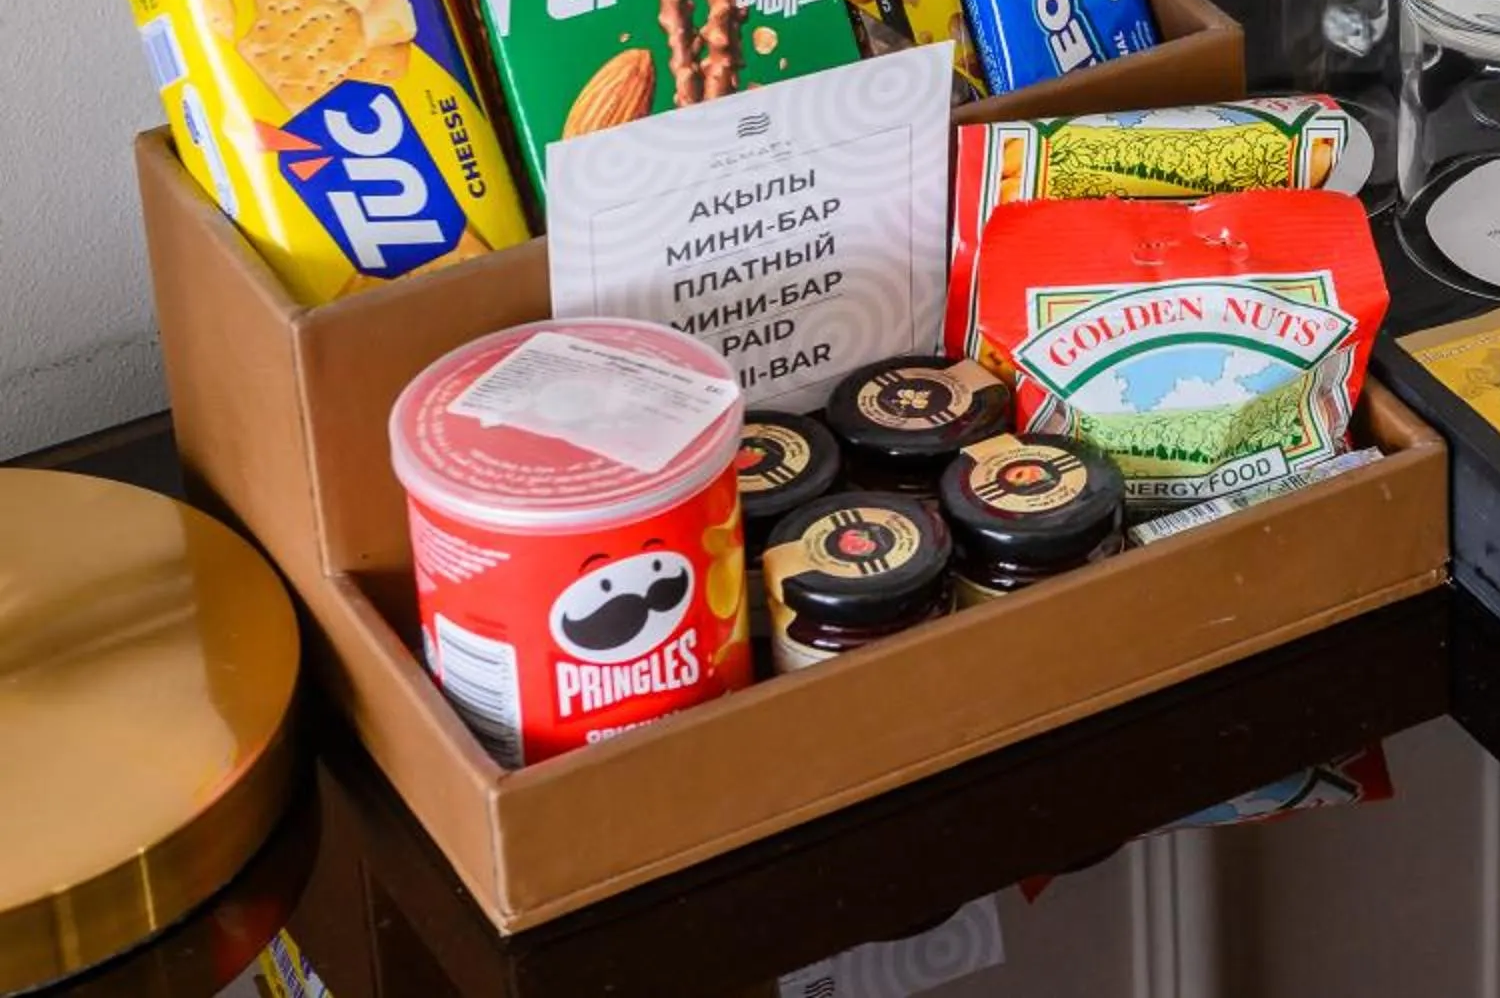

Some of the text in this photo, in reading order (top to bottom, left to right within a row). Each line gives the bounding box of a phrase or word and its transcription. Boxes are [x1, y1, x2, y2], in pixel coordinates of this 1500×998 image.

[323, 93, 446, 269] TUC
[439, 95, 487, 199] CHEESE
[688, 169, 816, 223] АҚЫЛЫ
[666, 198, 842, 267] МИНИ-БАР
[673, 231, 836, 302] ПЛАТНЫЙ
[670, 270, 843, 335] МИНИ-БАР
[1049, 297, 1321, 367] GOLDEN NUTS
[722, 318, 796, 357] PAID
[740, 343, 832, 388] I-BAR
[1124, 457, 1272, 498] NERGY FOOD
[556, 628, 699, 717] PRINGLES
